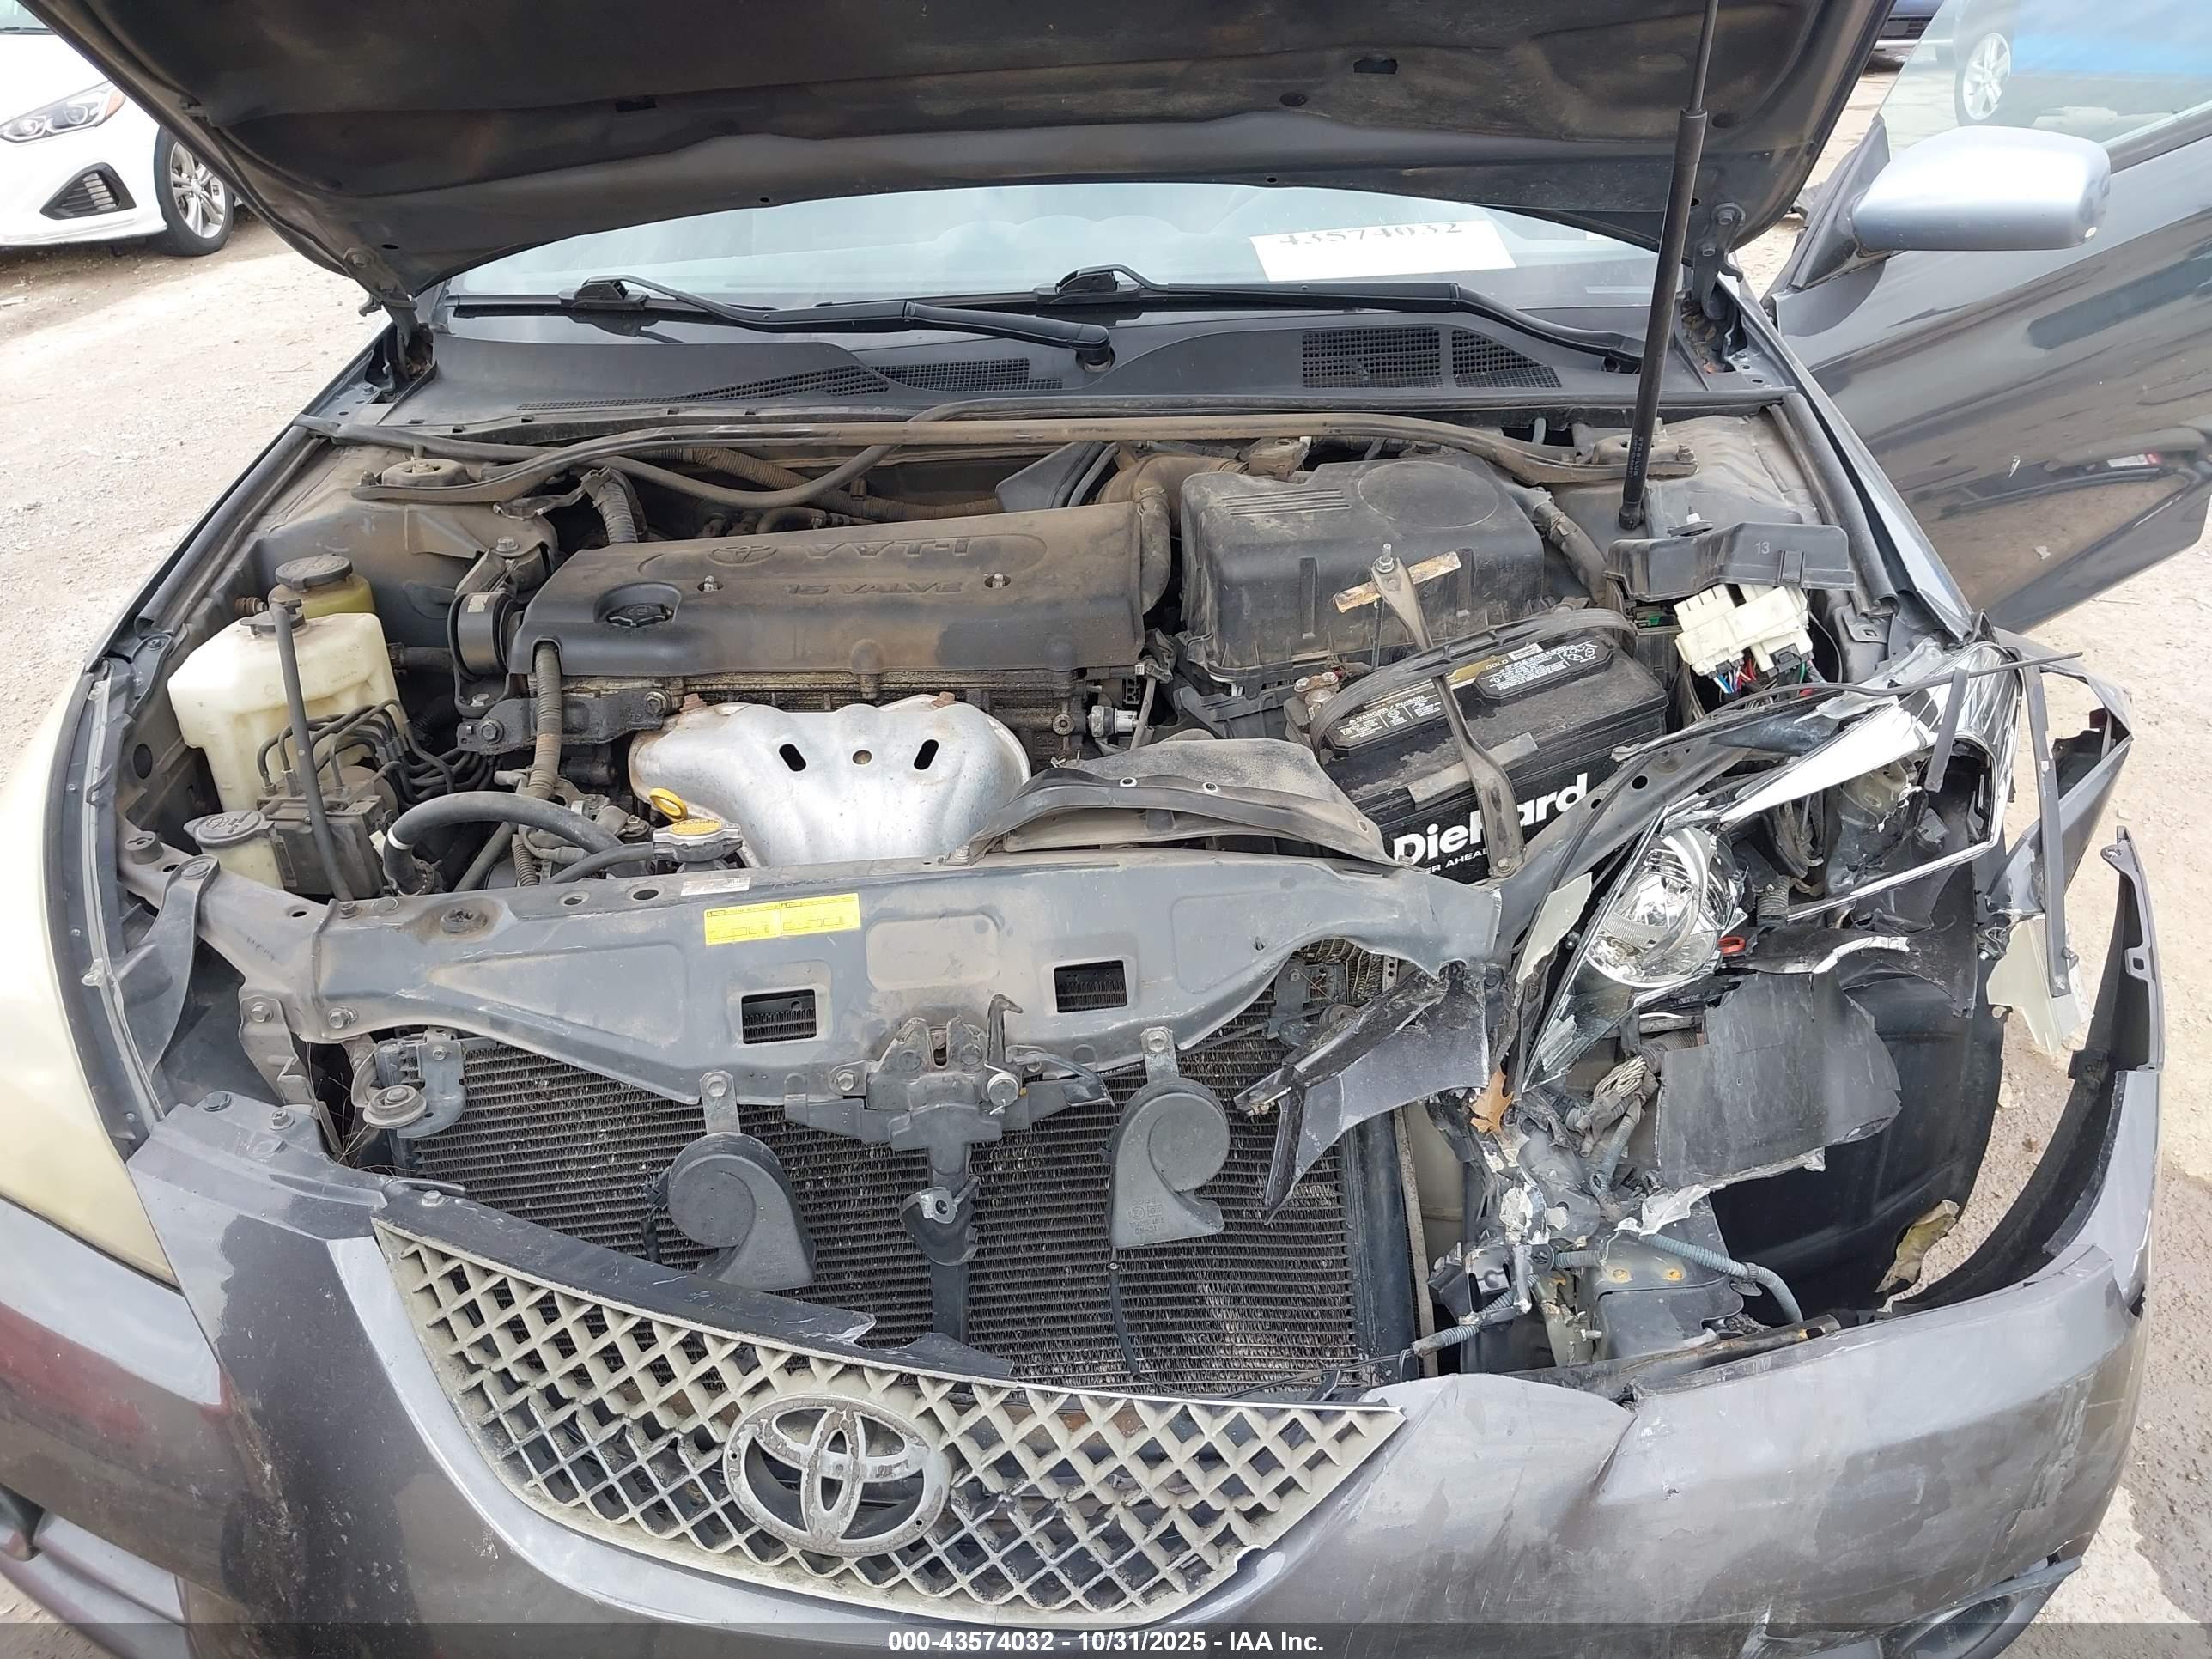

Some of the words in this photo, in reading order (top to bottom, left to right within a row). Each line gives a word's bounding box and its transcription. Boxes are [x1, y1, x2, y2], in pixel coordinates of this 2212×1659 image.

[1279, 222, 1462, 246] 43574032
[1753, 541, 1770, 555] 13
[1486, 659, 1509, 670] GOLD
[1356, 708, 1389, 721] DANGER
